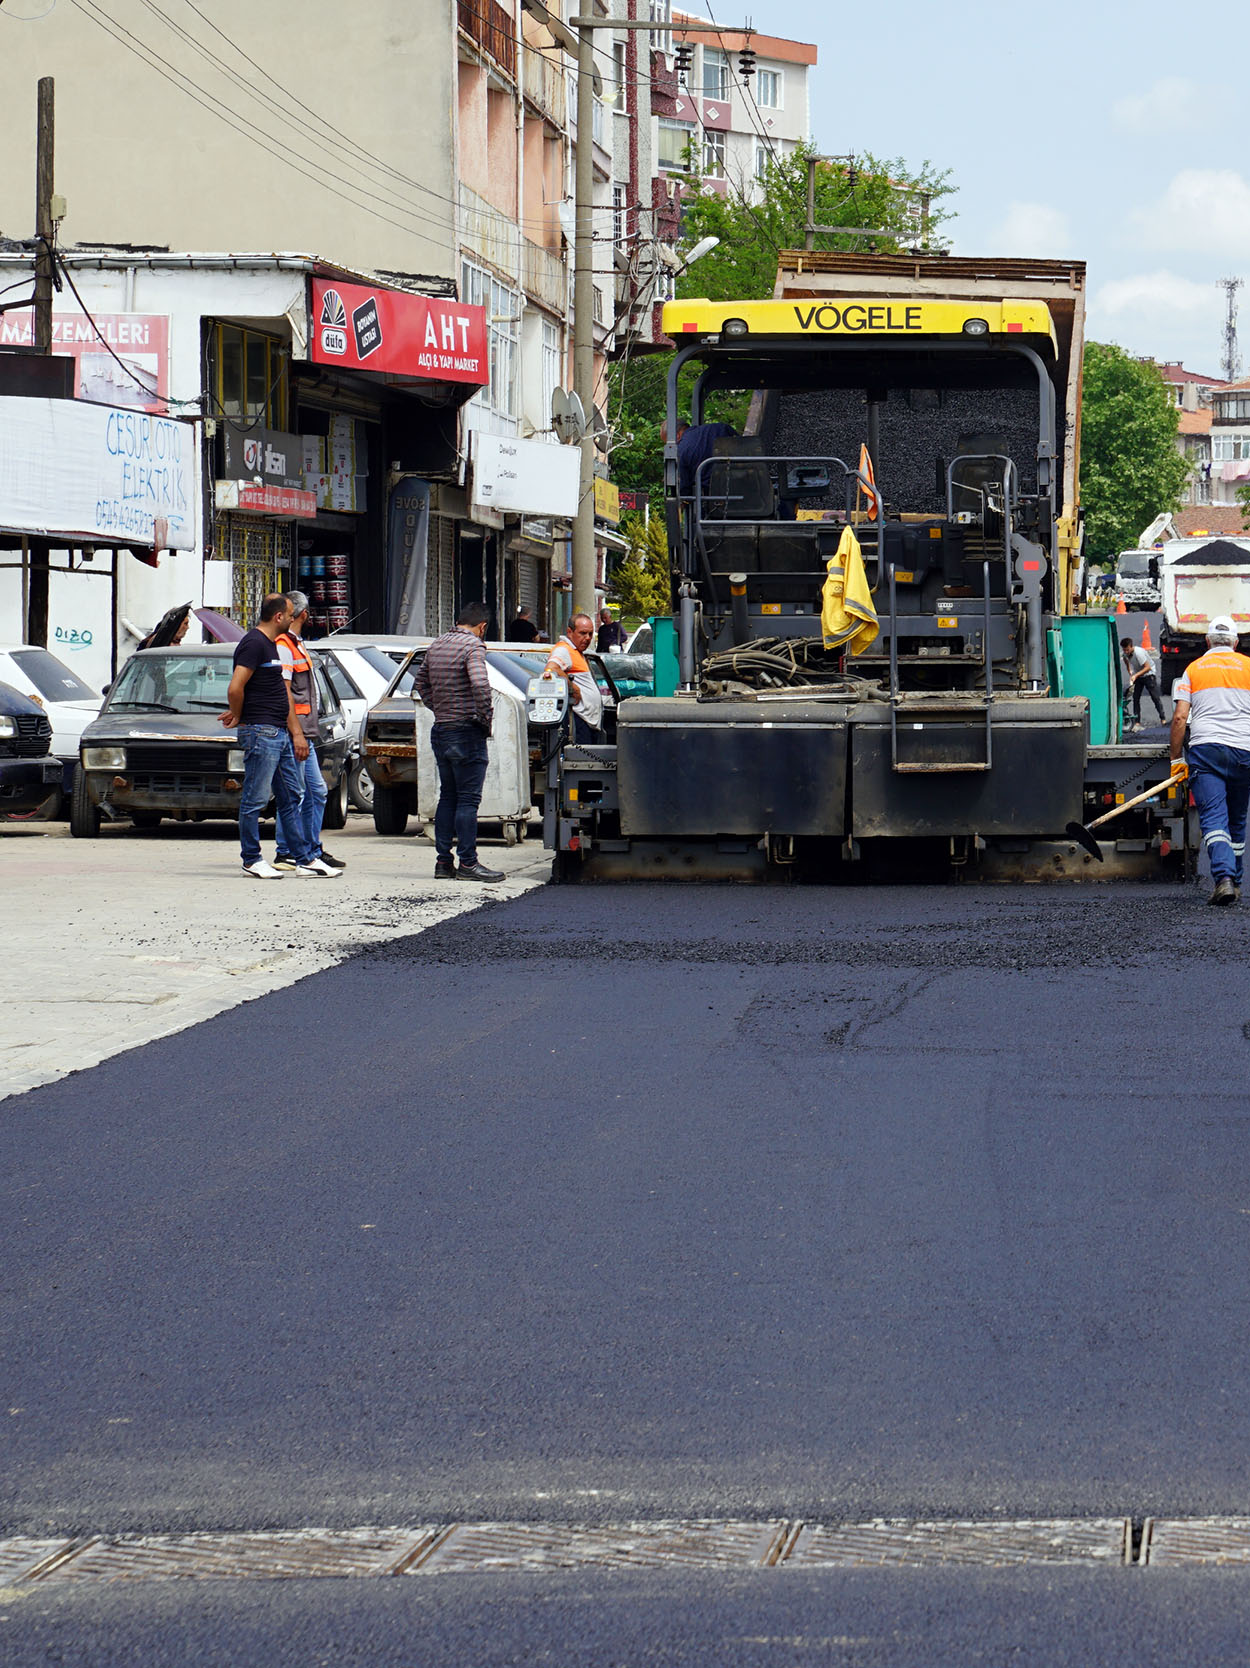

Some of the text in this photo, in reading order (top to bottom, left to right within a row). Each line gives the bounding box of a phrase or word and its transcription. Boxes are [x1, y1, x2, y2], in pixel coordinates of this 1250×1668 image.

[793, 301, 922, 331] VÖGELE
[1, 320, 149, 345] MAZEMELERİ
[325, 333, 343, 349] düfa
[424, 311, 470, 353] AHT
[439, 354, 453, 370] YAPI
[454, 356, 479, 373] MARKET
[106, 412, 152, 462] CESUR
